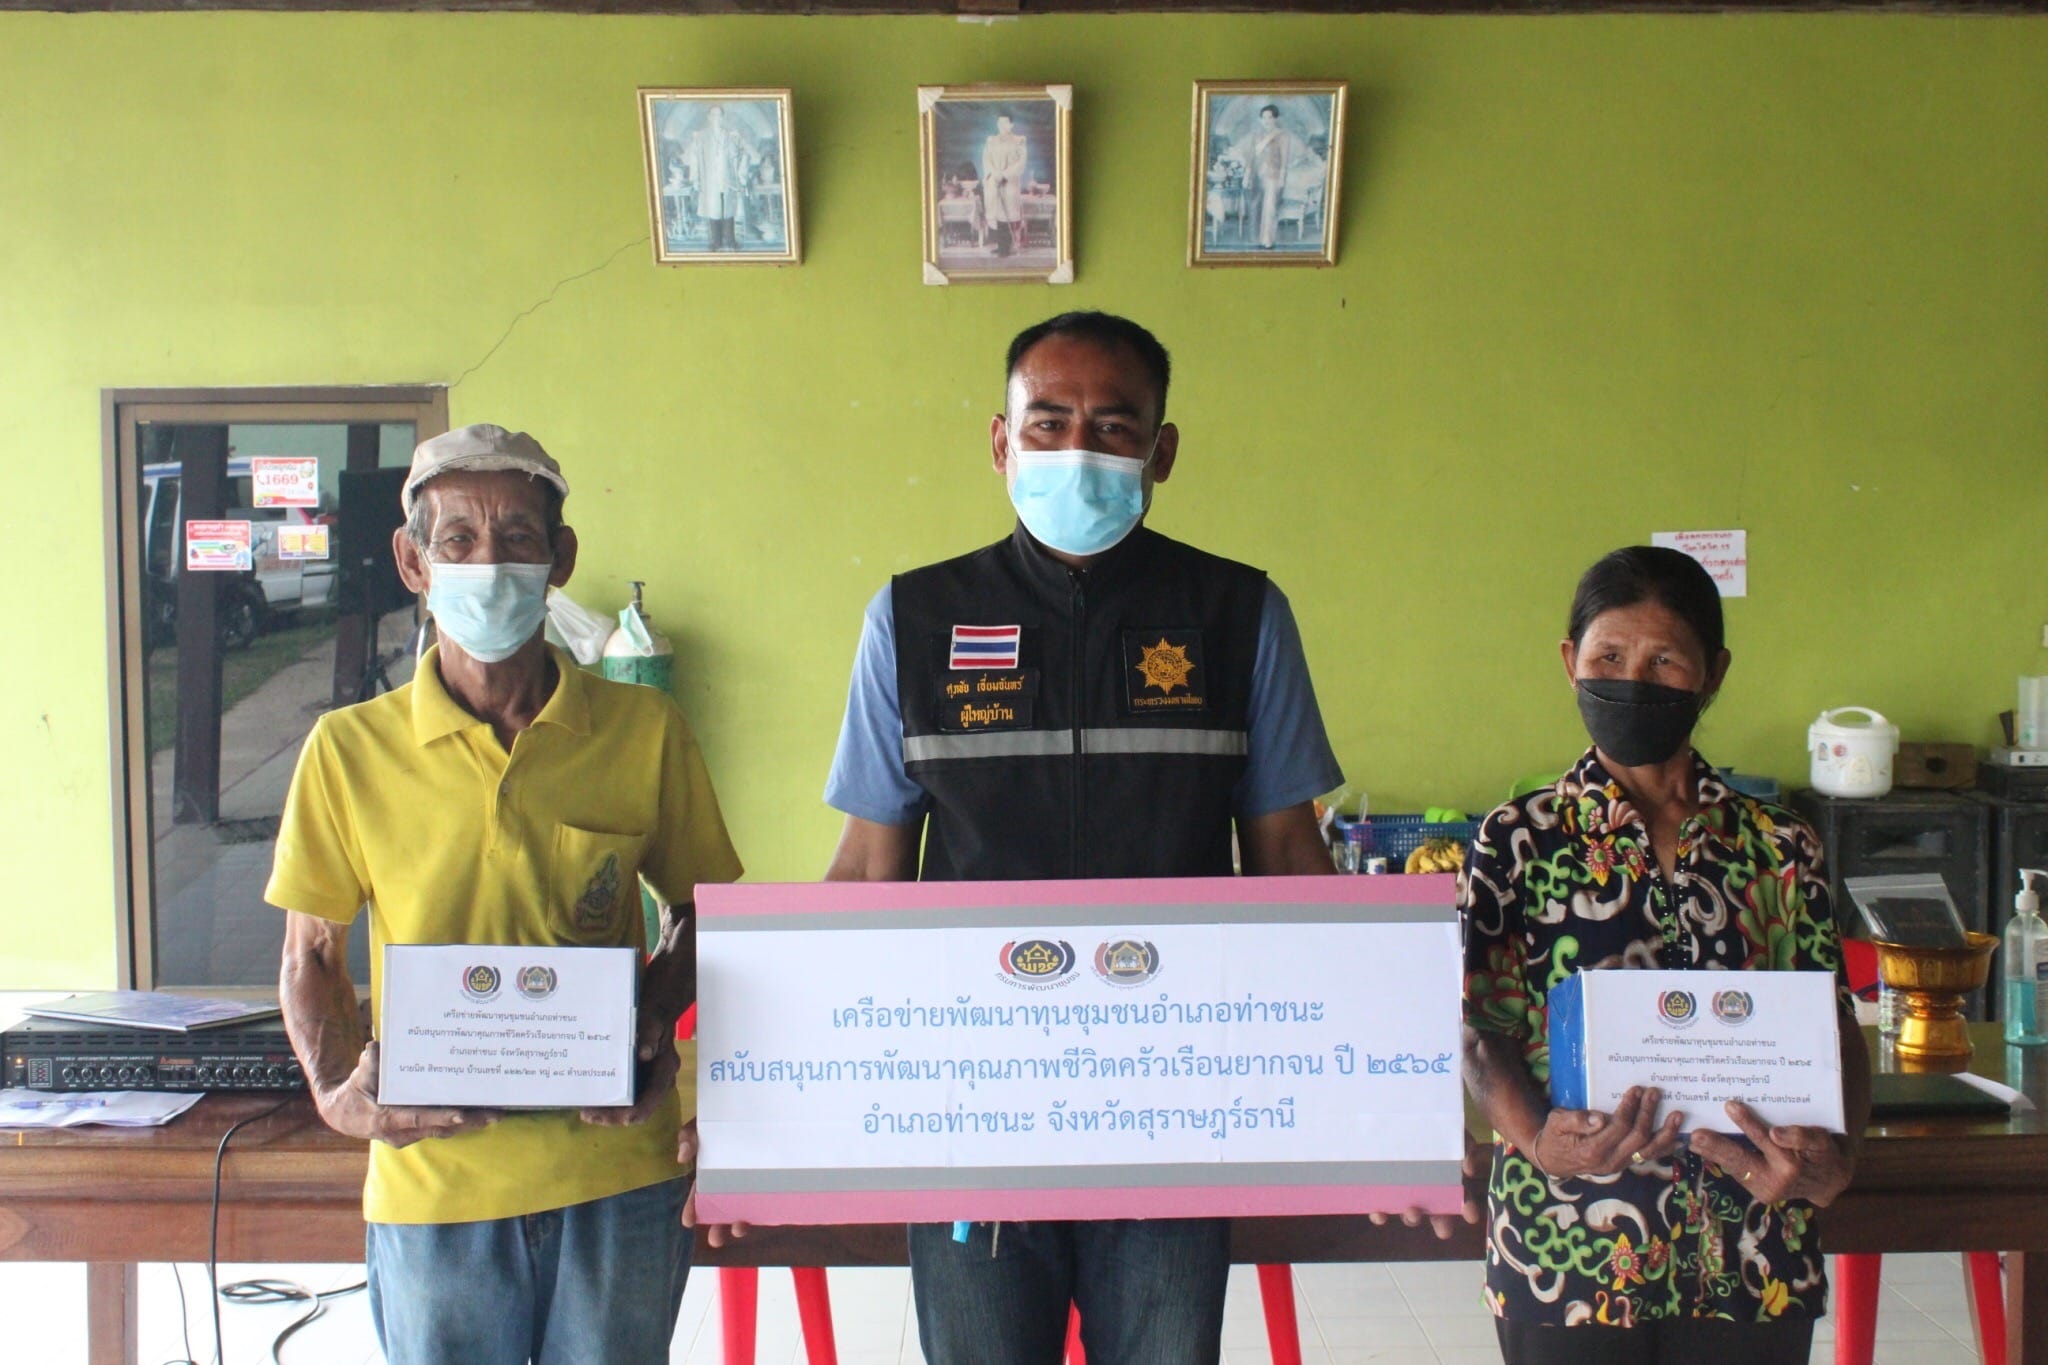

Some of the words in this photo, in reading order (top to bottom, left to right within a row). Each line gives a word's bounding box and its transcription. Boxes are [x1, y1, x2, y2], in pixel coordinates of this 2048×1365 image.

[265, 475, 298, 485] 1669
[960, 703, 1014, 728] ผู้ใหญ่บ้าน
[995, 971, 1080, 992] กรมการพัฒนาชุมชน
[833, 995, 1324, 1037] เครือข่ายพัฒนาทุนชุมชนอำเภอท่าชนะ
[709, 1045, 1324, 1091] สนับสนุนการพัฒนาคุณภาพชีวิตครัวเรือนยากจน
[1335, 1043, 1354, 1075] ปี
[1366, 1053, 1454, 1075] ๒๕๖๕
[863, 1103, 1035, 1134] อำเภอท่าชนะ
[1047, 1097, 1295, 1140] จังหวัดสุราษฎร์ธานี
